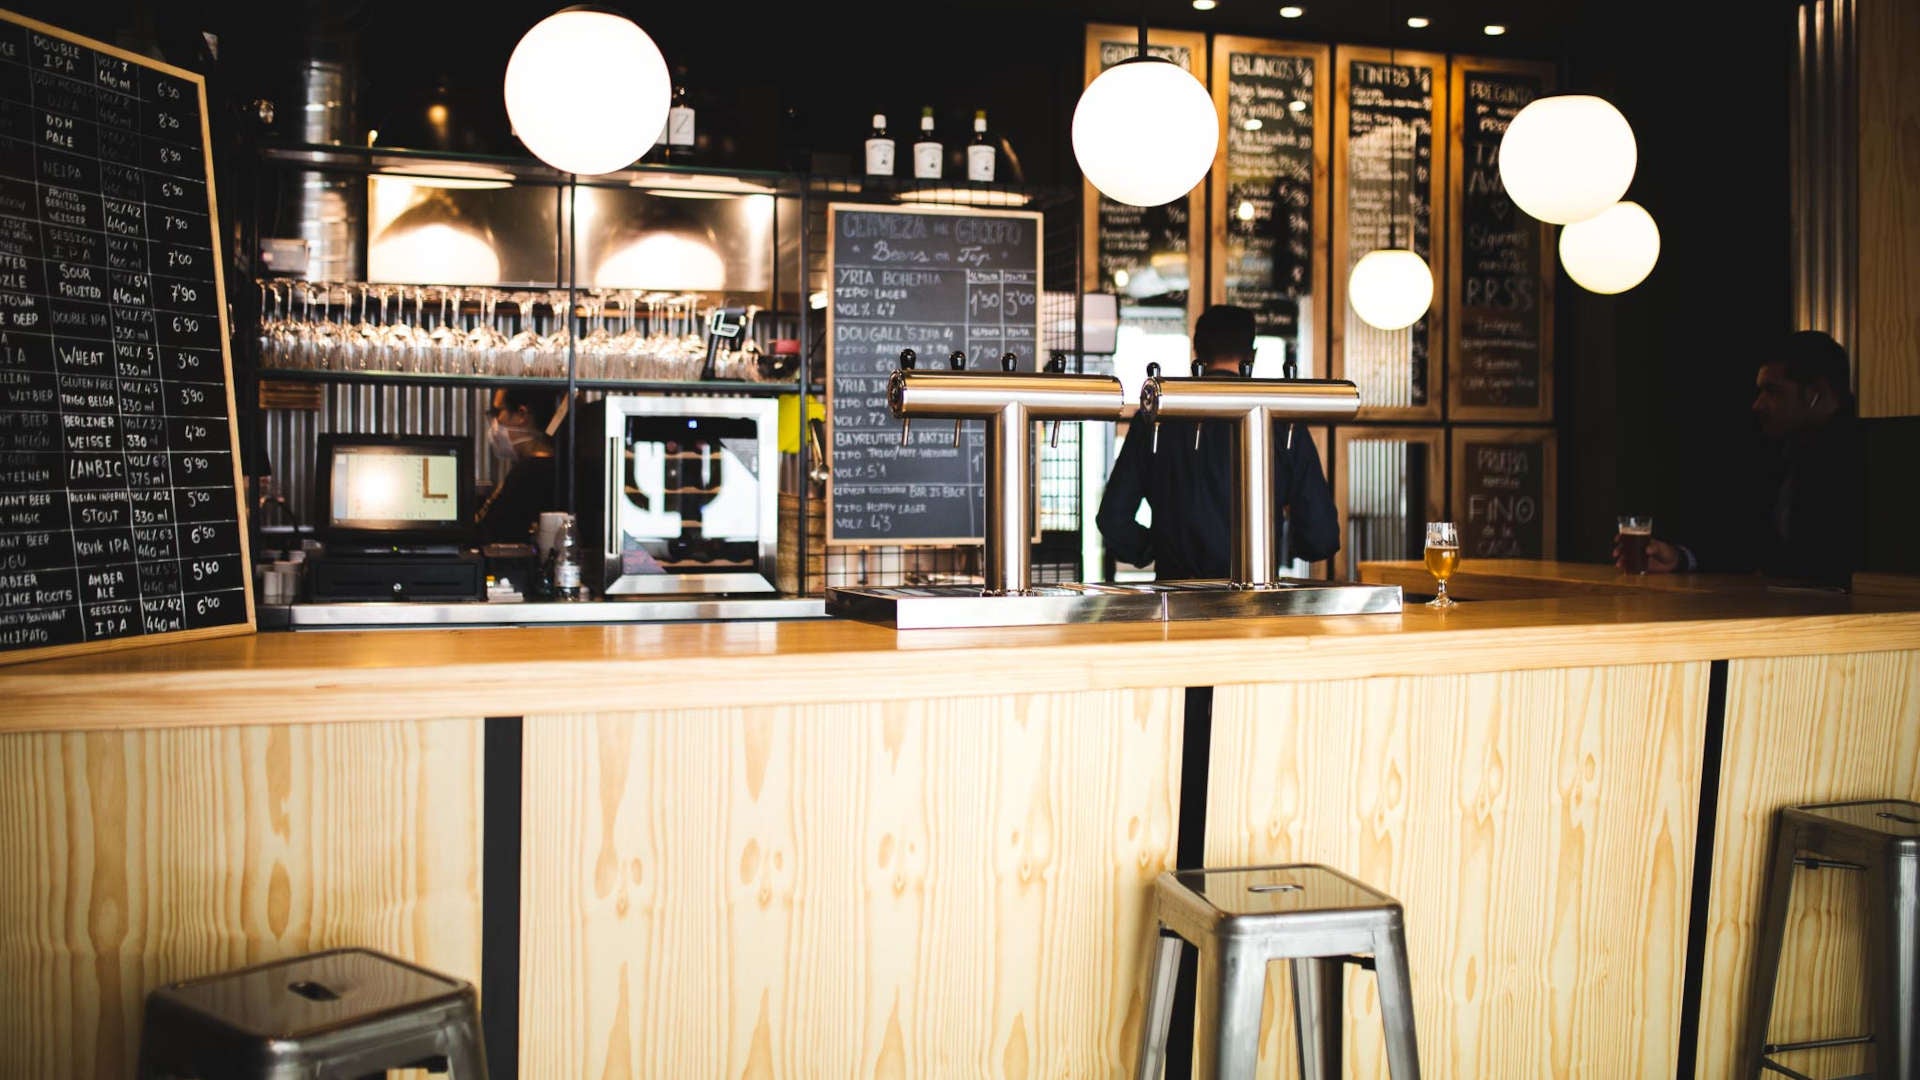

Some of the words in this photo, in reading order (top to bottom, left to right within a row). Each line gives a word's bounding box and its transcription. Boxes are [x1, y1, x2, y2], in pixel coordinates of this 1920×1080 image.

[32, 34, 80, 59] DOUBLE
[42, 54, 75, 73] IPA
[1355, 62, 1411, 88] TINTOS
[46, 112, 73, 130] DDH
[46, 130, 74, 148] PALE
[42, 160, 81, 178] NEIPA
[108, 216, 128, 234] 440
[128, 224, 139, 235] ml
[843, 213, 928, 239] CERVEZA
[872, 239, 930, 263] Beers
[59, 263, 92, 281] SOUR
[839, 269, 874, 286] YRIA
[882, 270, 944, 287] BOHEMIA
[59, 282, 101, 299] FRUITED
[113, 288, 132, 304] 440
[170, 284, 198, 303] 7'90
[874, 288, 908, 300] LAGER
[1004, 290, 1036, 316] 3'00
[12, 312, 39, 326] DEEP
[172, 315, 199, 333] 6'90
[837, 325, 916, 342] DOUGALL'S
[59, 346, 105, 366] WHEAT
[118, 363, 140, 377] 330
[836, 377, 868, 394] YRIA
[62, 394, 85, 406] TRIGO
[88, 395, 115, 407] BELGA
[121, 398, 142, 412] 330
[180, 388, 204, 406] 3'90
[64, 415, 115, 428] BERLINER
[68, 435, 112, 449] WEISSE
[126, 434, 148, 448] 330
[184, 424, 207, 442] 4'20
[70, 459, 122, 480] LAMBIC
[183, 456, 209, 475] 9'90
[130, 472, 151, 486] 375
[153, 473, 165, 485] ml
[29, 493, 51, 506] BEER
[187, 491, 210, 509] 5'00
[82, 508, 120, 523] STOUT
[134, 508, 155, 523] 330
[1469, 494, 1536, 526] FINO
[870, 513, 893, 532] 4'3
[26, 533, 50, 547] BEER
[191, 526, 216, 545] 6'50
[109, 538, 130, 553] IPA
[88, 571, 125, 587] AMBER
[192, 561, 220, 581] 5'60
[36, 589, 73, 604] ROOTS
[97, 587, 115, 600] ALE
[90, 605, 132, 617] SESSION
[197, 598, 221, 616] 6'00
[95, 618, 128, 636] IPA
[146, 616, 168, 633] 440
